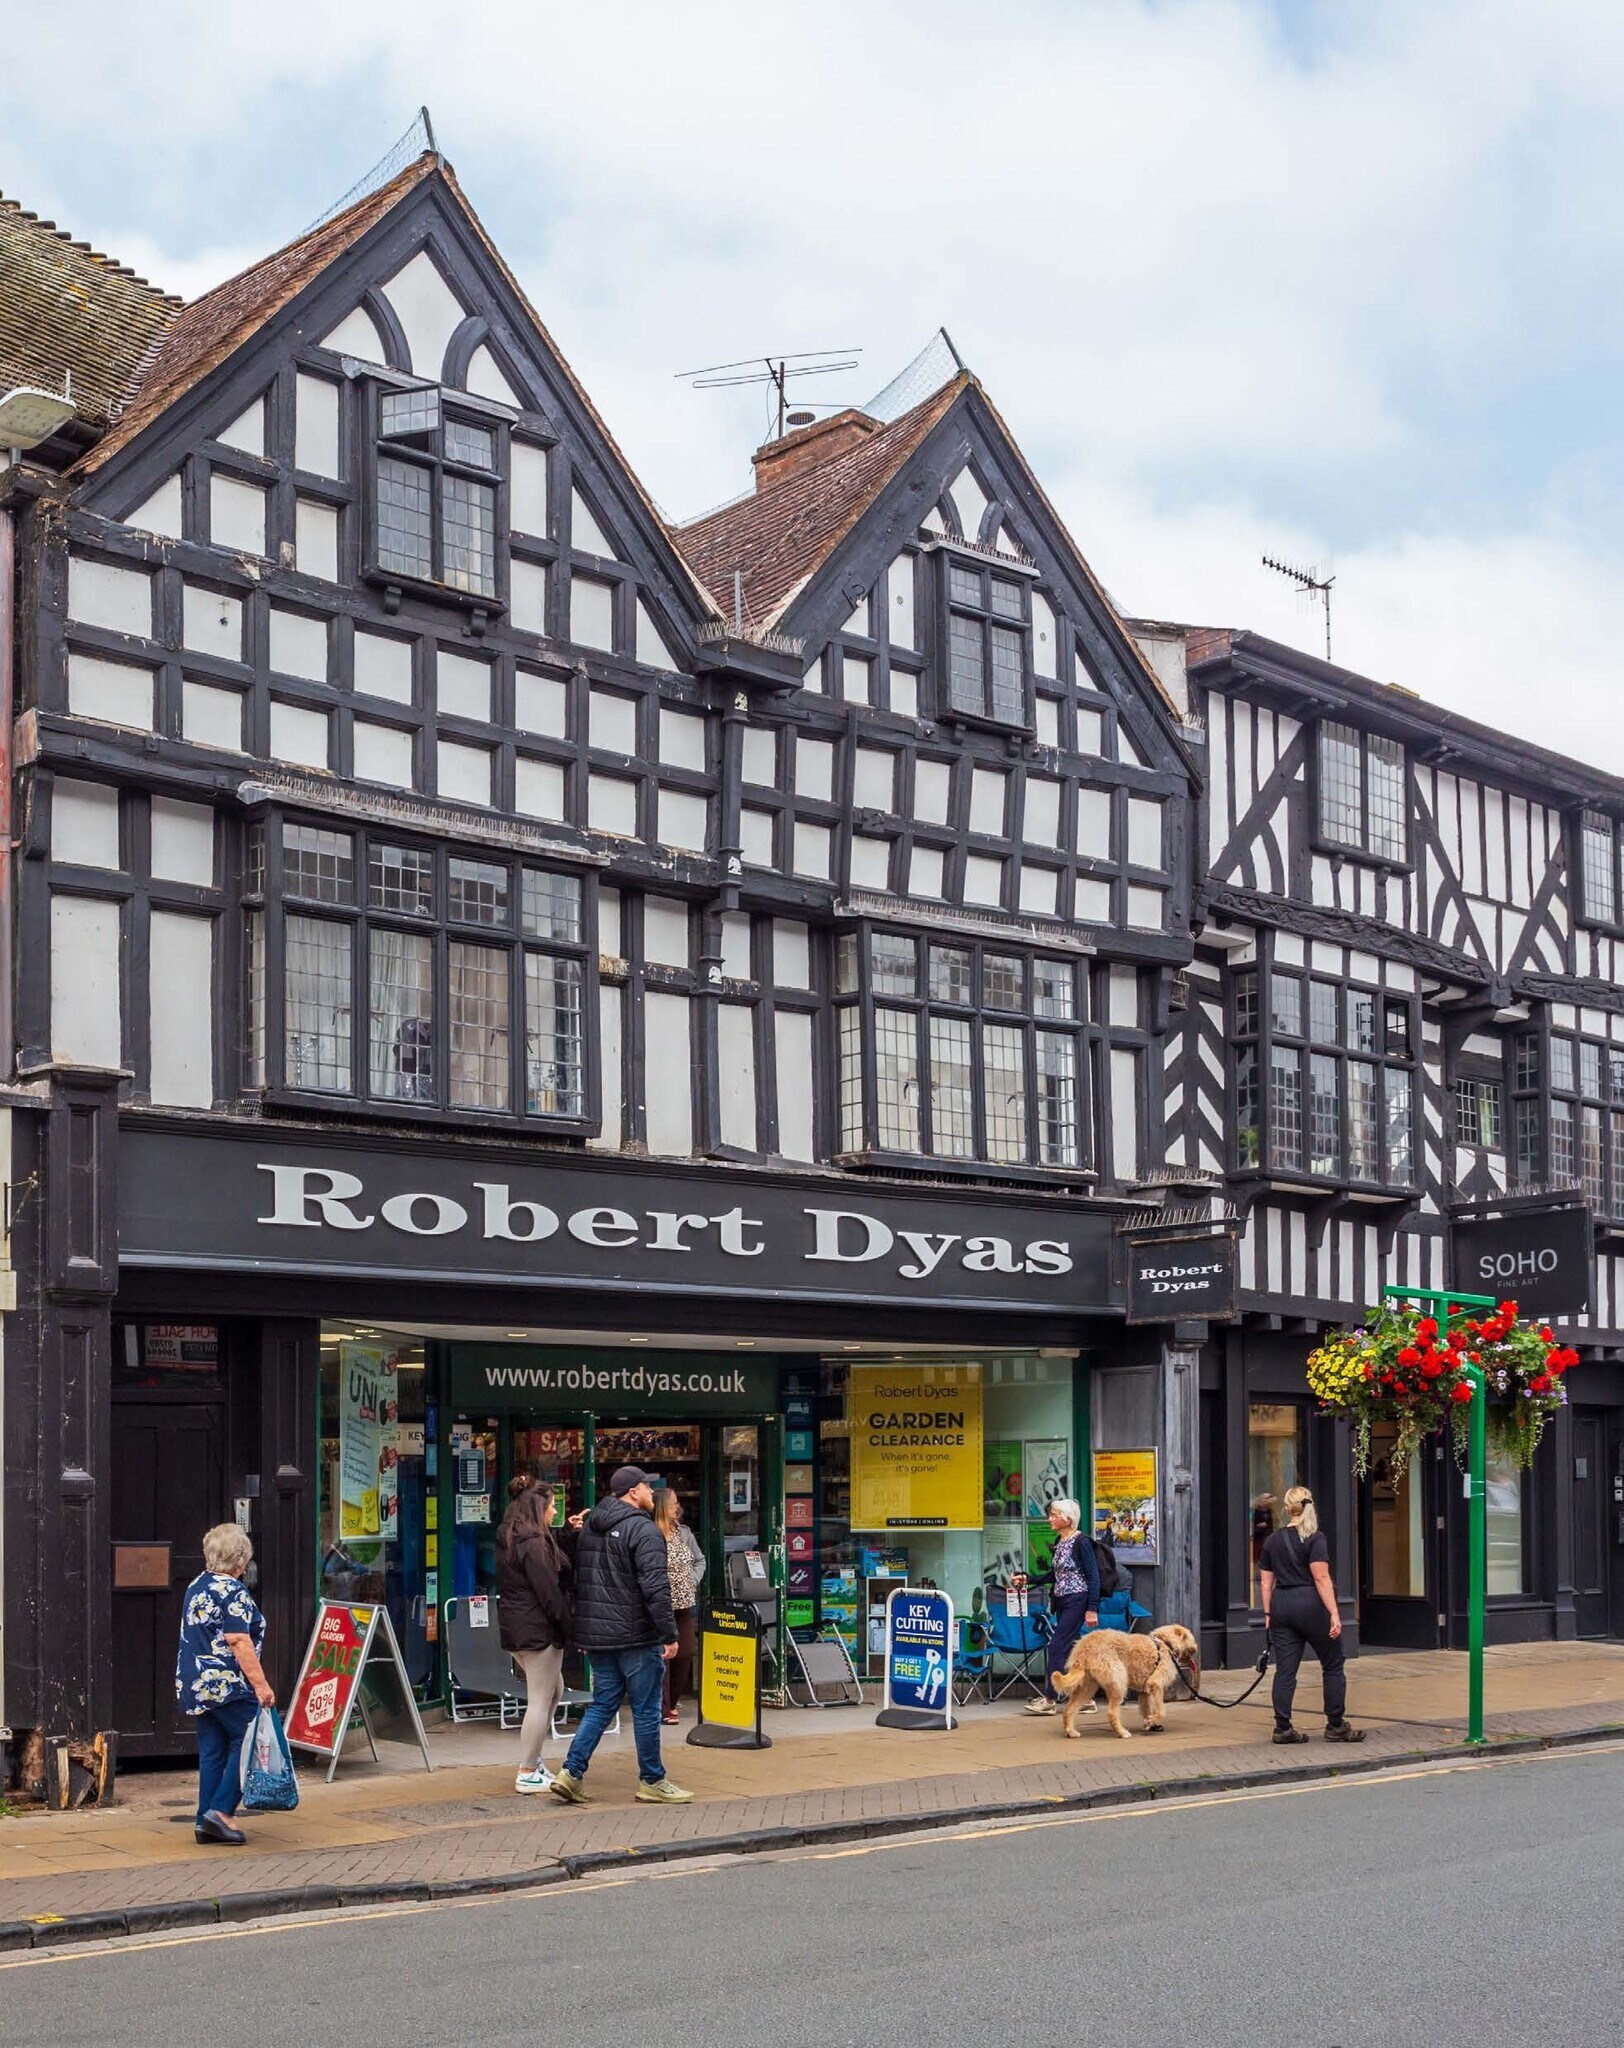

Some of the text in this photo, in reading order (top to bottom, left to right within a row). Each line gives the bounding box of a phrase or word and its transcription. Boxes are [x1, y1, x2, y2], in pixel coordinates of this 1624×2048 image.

[257, 1163, 1073, 1278] Robert Dyas
[1479, 1248, 1558, 1279] SOHO
[1140, 1263, 1223, 1280] Robert
[1151, 1281, 1210, 1293] Dyas
[1521, 1278, 1539, 1286] ART
[485, 1364, 746, 1397] www.robertdyas.co.uk
[874, 1384, 958, 1400] Robert Dyas
[868, 1412, 964, 1430] GARDEN
[869, 1434, 965, 1447] CLEARANCE
[880, 1452, 909, 1461] When
[911, 1452, 923, 1461] it's
[895, 1464, 938, 1475] it's gone!
[787, 1601, 812, 1612] Free
[909, 1604, 931, 1618] KEY
[712, 1610, 736, 1621] Western
[323, 1617, 341, 1632] BIG
[896, 1617, 944, 1633] CUTTING
[320, 1631, 345, 1643] GARDEN
[896, 1636, 944, 1646] AVAILABLE IN-STORE
[312, 1642, 361, 1675] SALE
[713, 1651, 744, 1664] Send and
[716, 1666, 740, 1677] receive
[894, 1664, 922, 1677] FREE
[312, 1683, 334, 1697] UP TO
[716, 1679, 739, 1690] money
[308, 1693, 334, 1714] 50%
[720, 1692, 735, 1702] here
[313, 1708, 328, 1722] OFF
